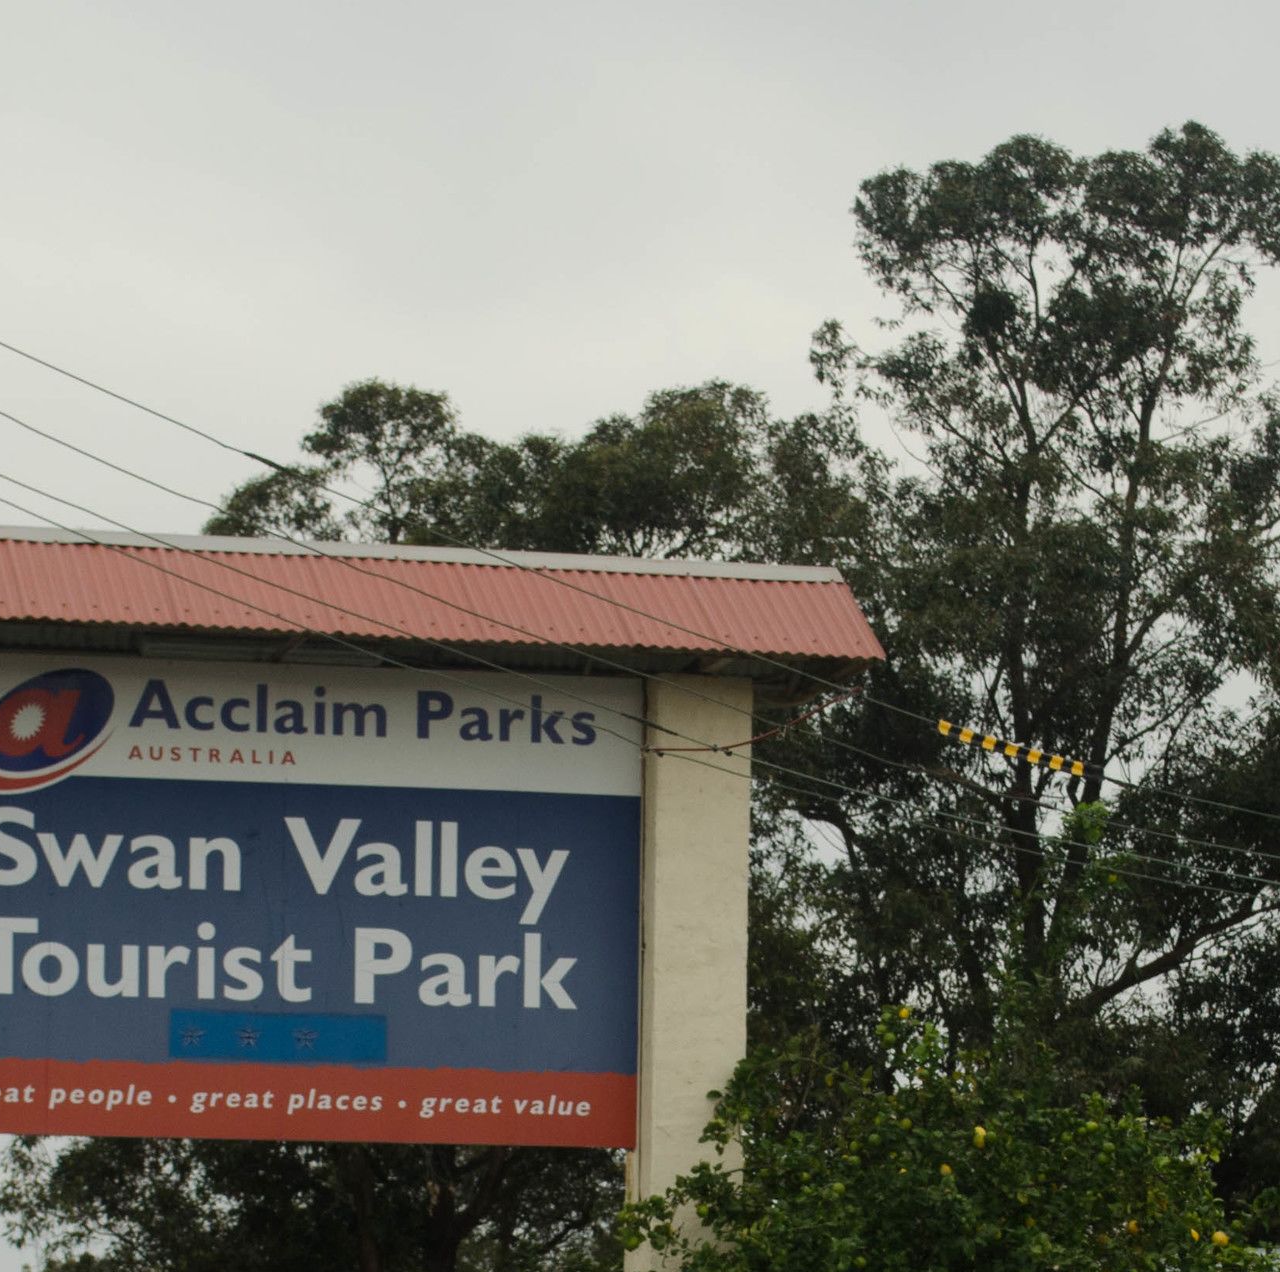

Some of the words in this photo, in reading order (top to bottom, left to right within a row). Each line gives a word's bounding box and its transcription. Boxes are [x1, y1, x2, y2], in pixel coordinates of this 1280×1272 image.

[128, 678, 388, 738] Acclaim
[416, 689, 597, 746] Parks
[128, 744, 297, 766] AUSTRALIA
[283, 816, 571, 925] Valley
[353, 926, 579, 1010] Park
[47, 1083, 153, 1112] people
[189, 1089, 275, 1114] great
[286, 1088, 384, 1115] places
[419, 1095, 503, 1119] great
[514, 1094, 592, 1117] value
